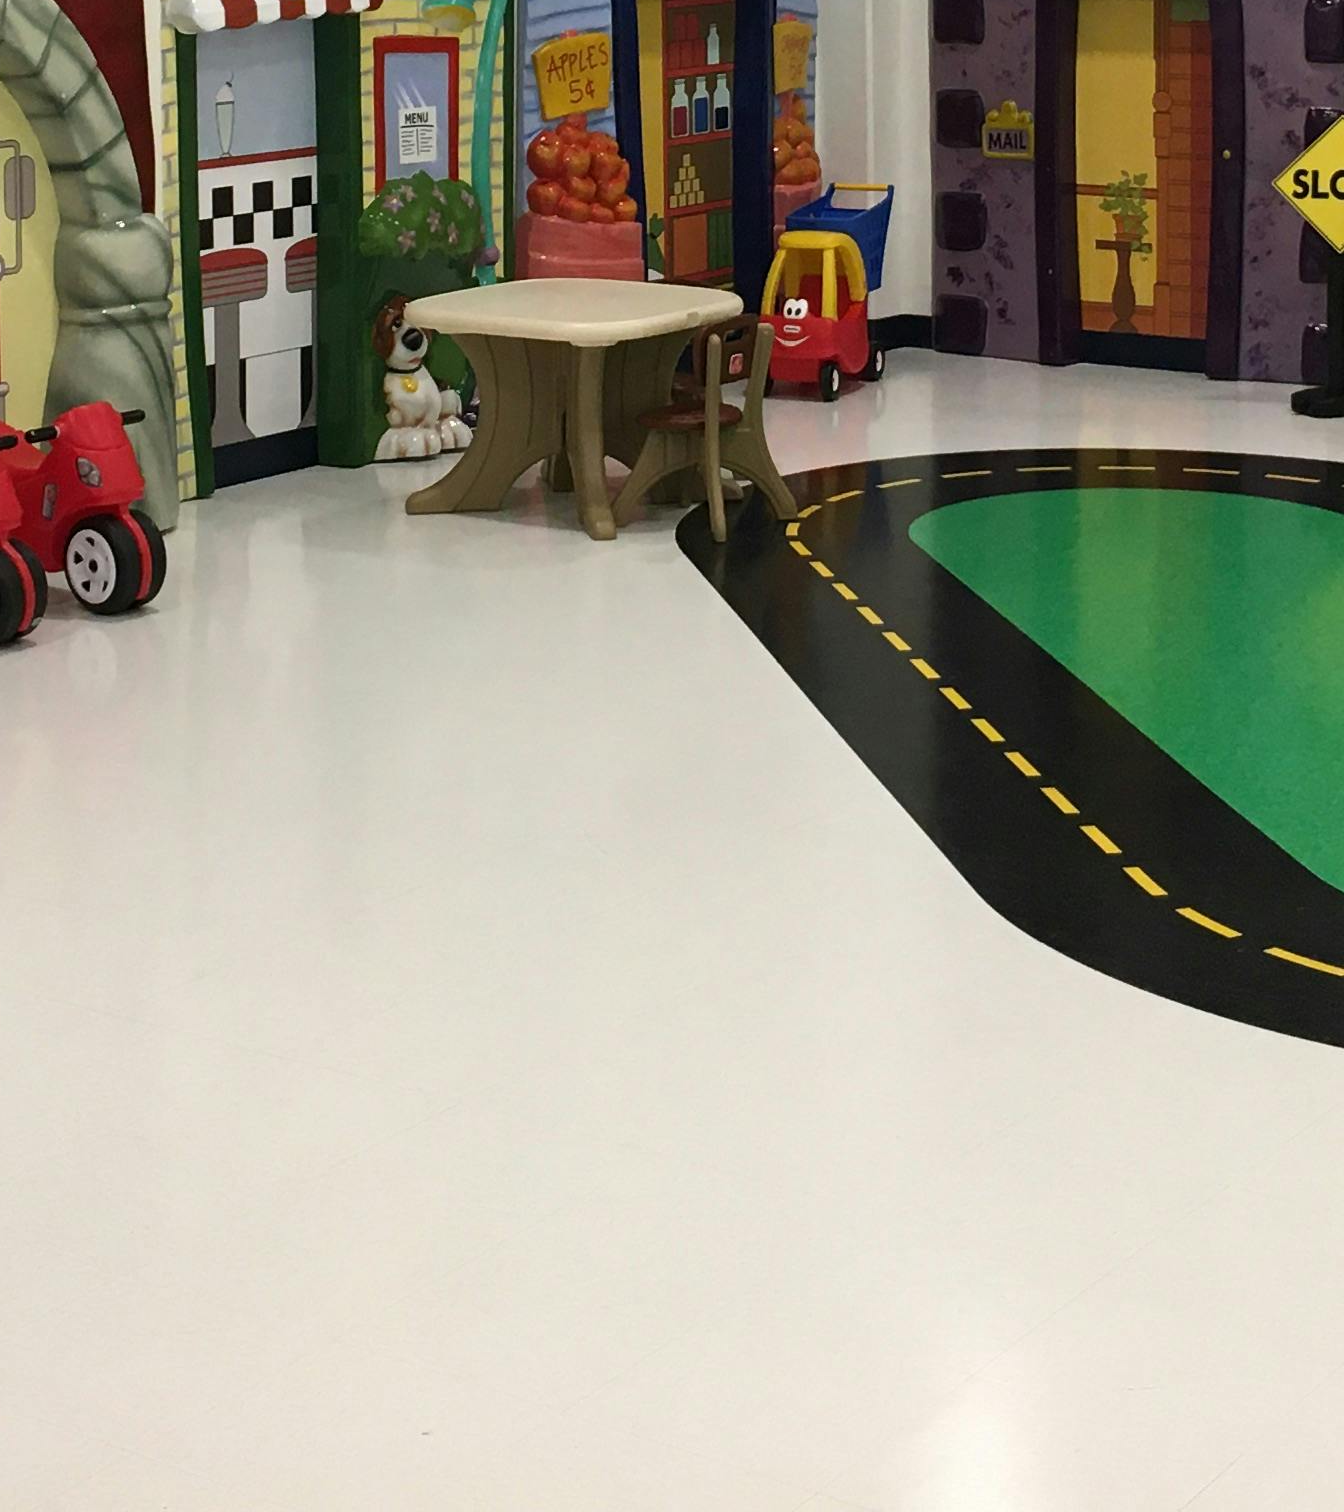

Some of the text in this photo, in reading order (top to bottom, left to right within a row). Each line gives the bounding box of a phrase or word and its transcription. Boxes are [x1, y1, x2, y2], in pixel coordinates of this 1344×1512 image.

[547, 42, 609, 83] APPLES
[404, 112, 429, 124] MENU
[988, 131, 1027, 151] MAIL
